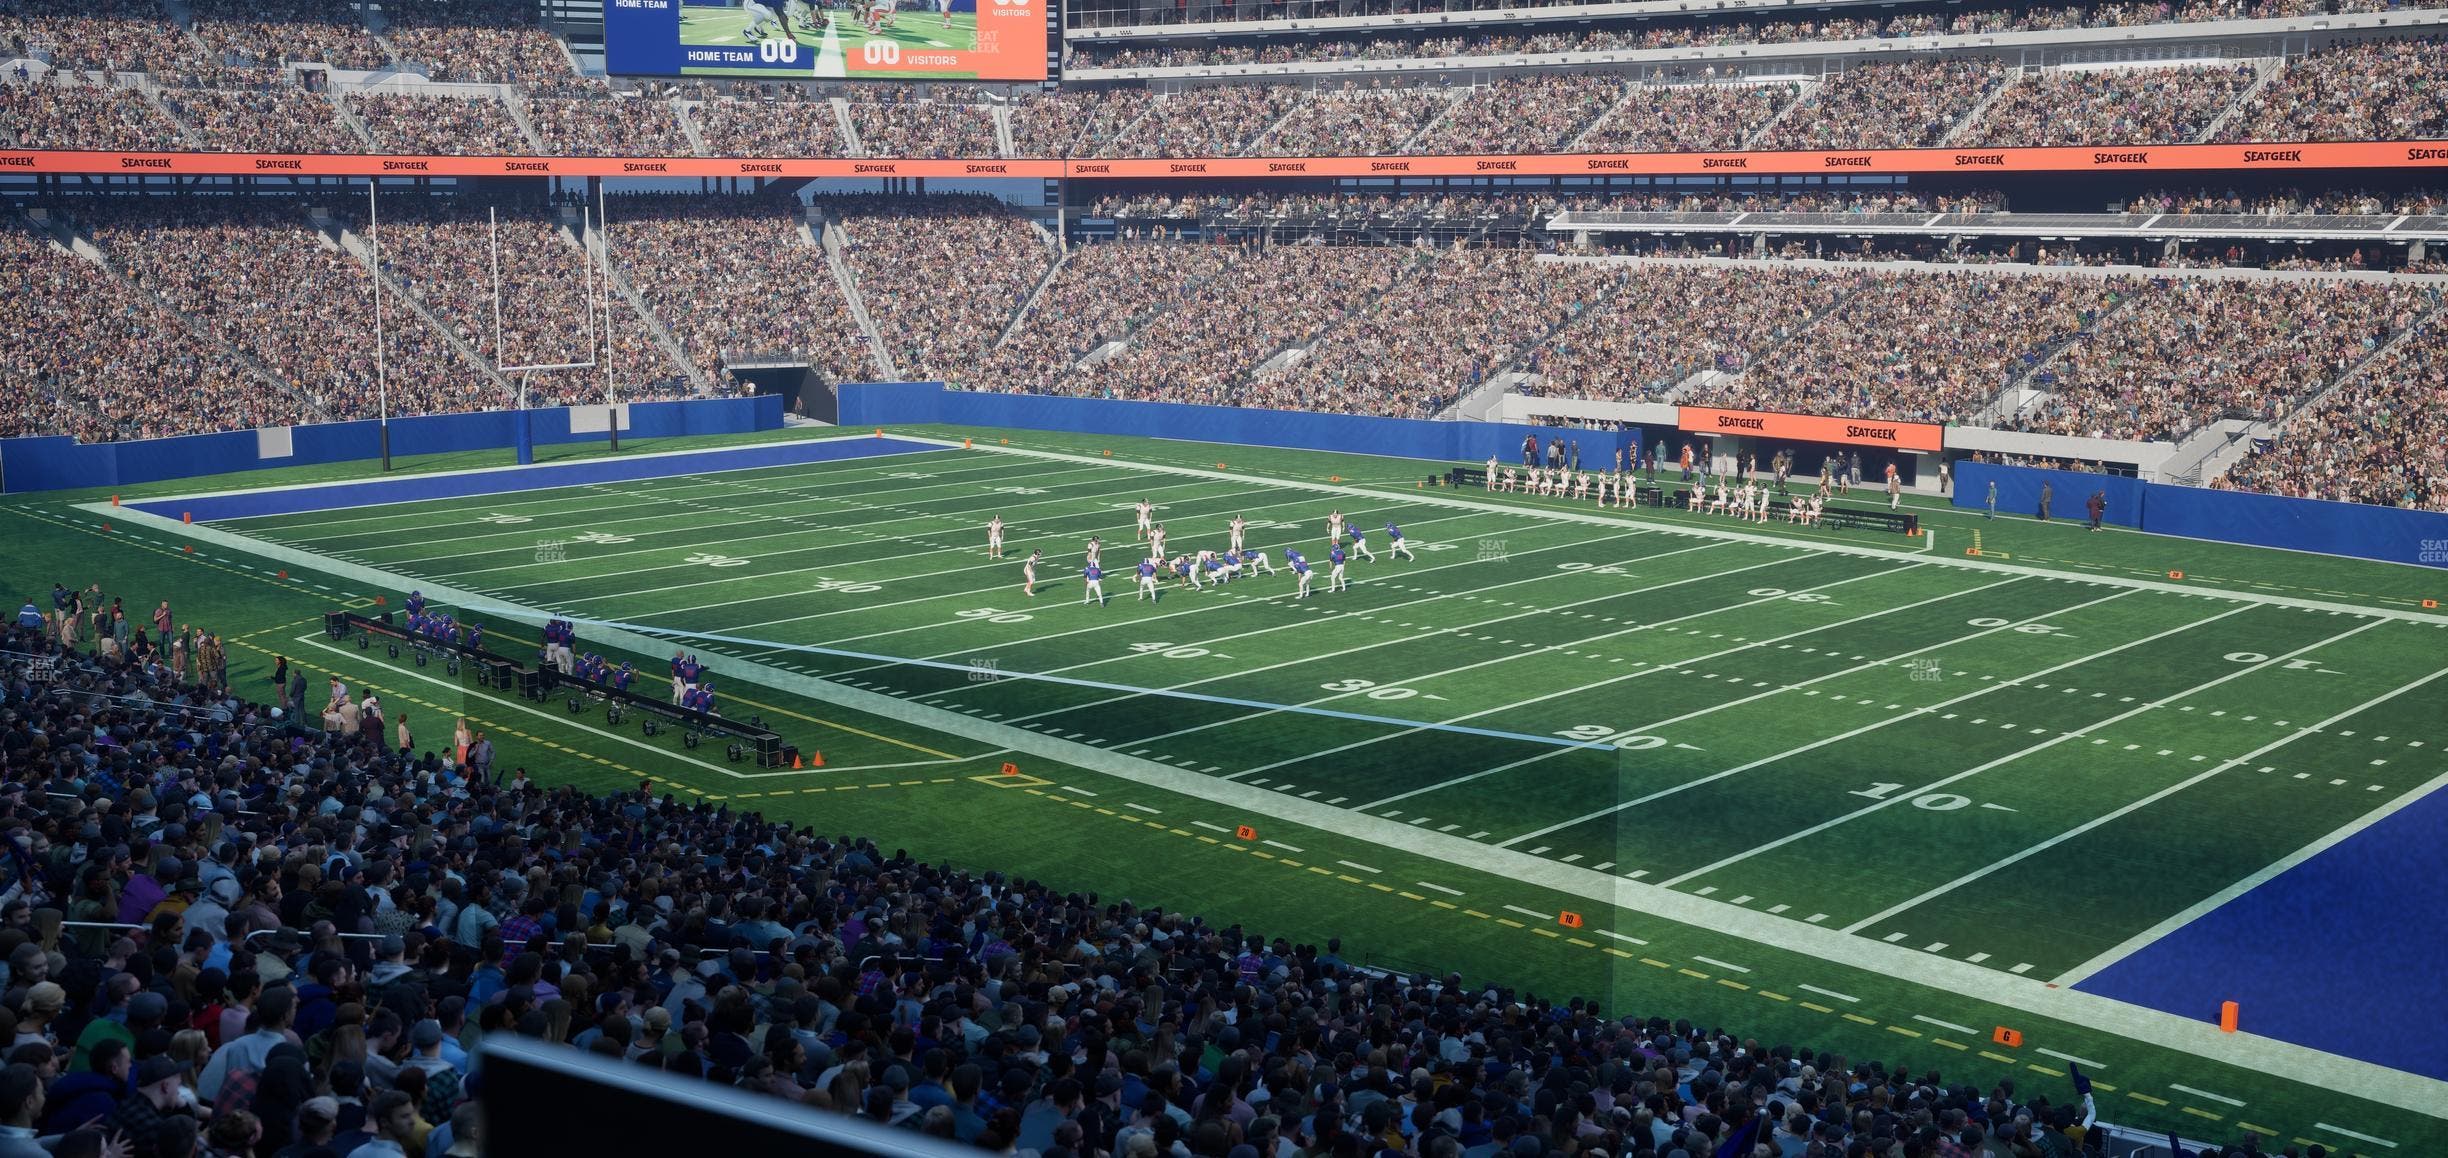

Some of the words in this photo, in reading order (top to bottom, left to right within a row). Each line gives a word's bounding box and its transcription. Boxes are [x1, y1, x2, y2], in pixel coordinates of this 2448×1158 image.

[616, 0, 641, 8] HOME
[643, 1, 667, 9] TEAM
[992, 9, 1031, 17] VISITORS
[688, 51, 720, 61] HOME
[724, 52, 753, 62] TEAM
[761, 39, 797, 63] 00
[864, 40, 900, 64] 00
[907, 56, 957, 65] VISITORS
[1955, 154, 2004, 166] SEATGEEK
[2094, 152, 2148, 164] SEATGEEK
[2243, 150, 2302, 163] SEATGEEK
[2408, 149, 2448, 160] SEATG
[121, 157, 172, 169] SEATGEEK
[255, 159, 302, 170] SEATGEEK
[383, 160, 429, 171] SEATGEEK
[505, 161, 550, 172] SEATGEEK
[623, 162, 667, 172] SEATGEEK
[1371, 162, 1410, 172] SEATGEEK
[1476, 160, 1517, 171] SEATGEEK
[1587, 159, 1629, 170] SEATGEEK
[1703, 158, 1747, 168] SEATGEEK
[1825, 156, 1872, 167] SEATGEEK
[740, 163, 783, 173] SEATGEEK
[854, 164, 896, 173] SEATGEEK
[966, 164, 1007, 173] SEATGEEK
[1075, 164, 1110, 173] SEATGEEK
[1170, 164, 1207, 173] SEATGEEK
[1269, 163, 1306, 172] SEATGEEK
[1718, 415, 1764, 431] SEATGEEK
[1846, 425, 1897, 441] SEATGEEK
[955, 607, 1033, 623] 50
[1967, 618, 2063, 634] 20
[1128, 642, 1210, 659] 40
[2223, 652, 2322, 669] 10
[1320, 680, 1418, 700] 30
[1553, 725, 1667, 750] 20
[1848, 782, 1972, 811] 10
[1565, 914, 1574, 925] 10
[2003, 1030, 2011, 1041] G
